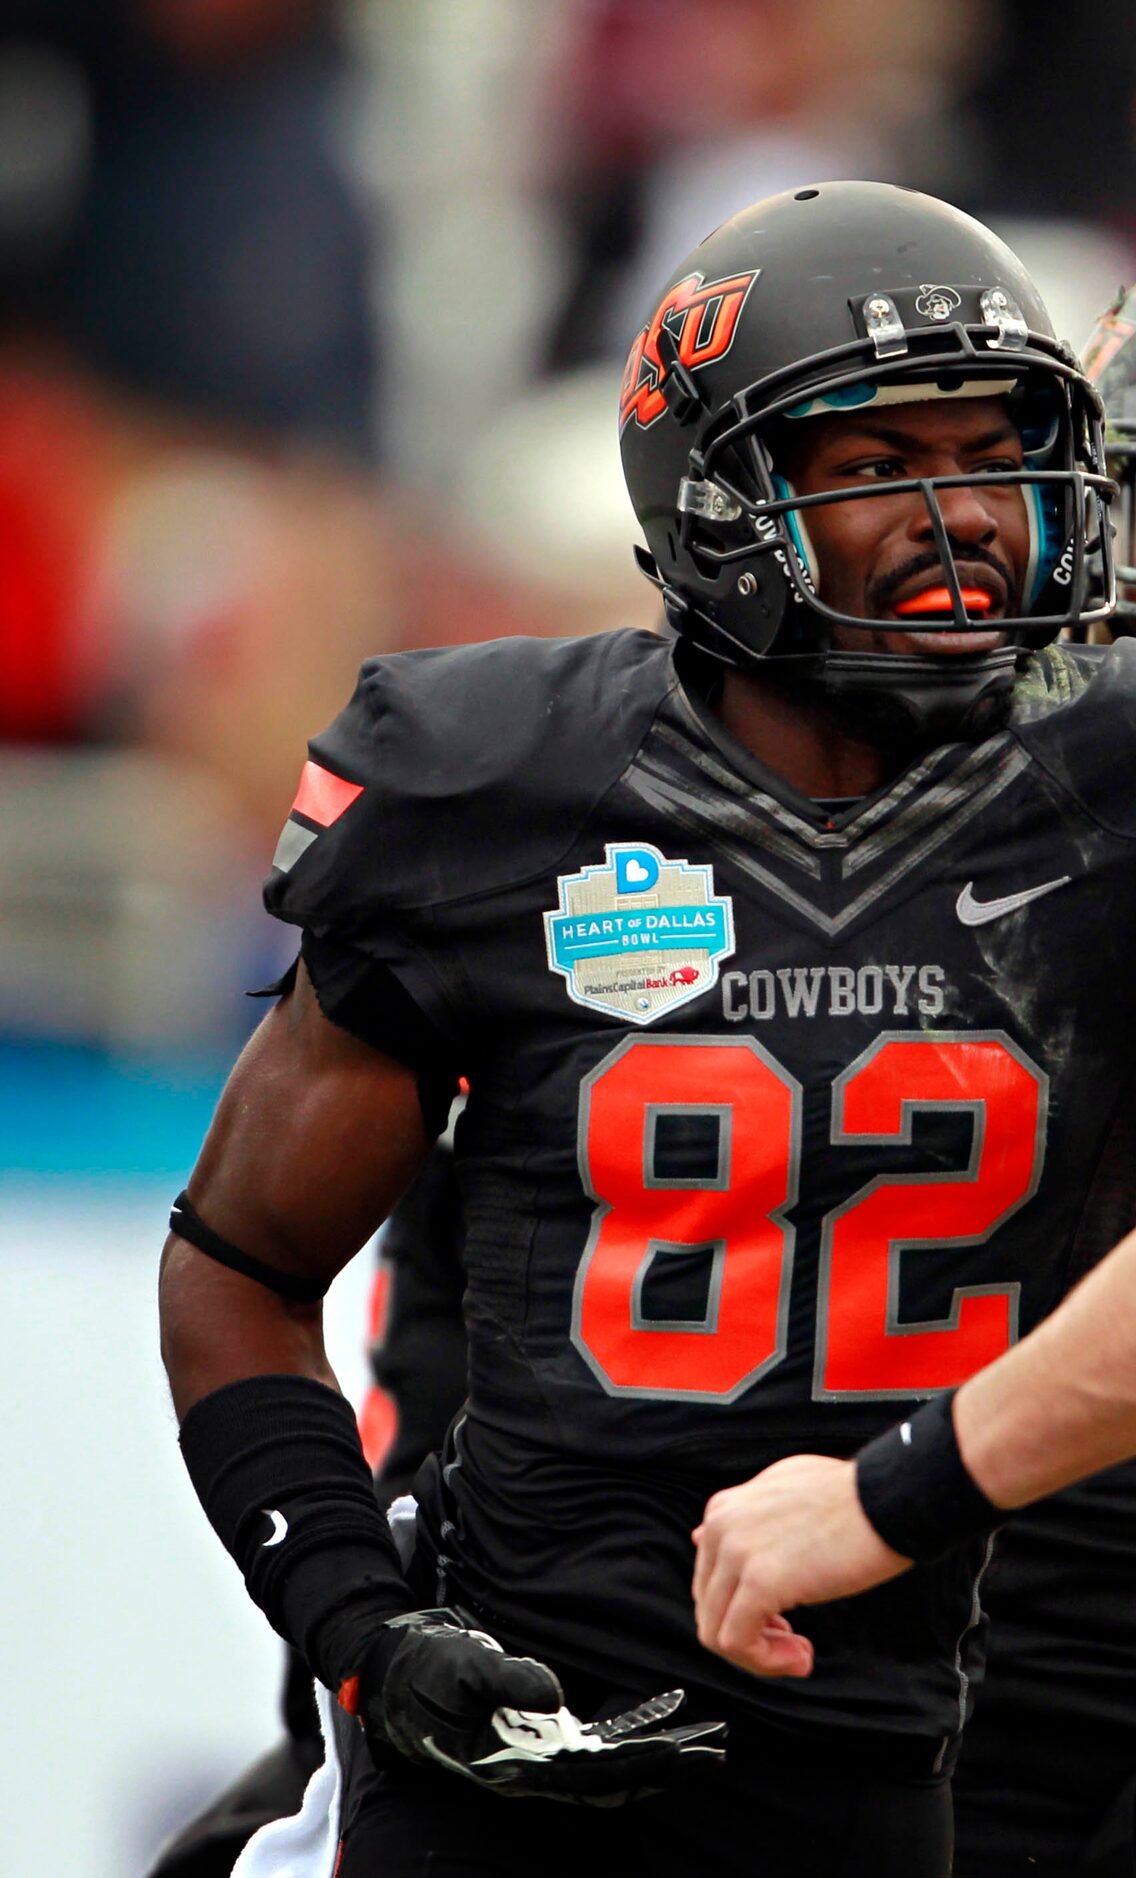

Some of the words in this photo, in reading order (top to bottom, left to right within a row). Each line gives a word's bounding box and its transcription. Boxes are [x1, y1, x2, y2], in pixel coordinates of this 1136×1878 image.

[618, 268, 761, 430] OSU
[562, 917, 624, 940] HEART
[646, 911, 717, 930] DALLAS
[621, 933, 660, 947] BOWL
[721, 964, 945, 1022] COWBOYS
[570, 1029, 1051, 1405] 82
